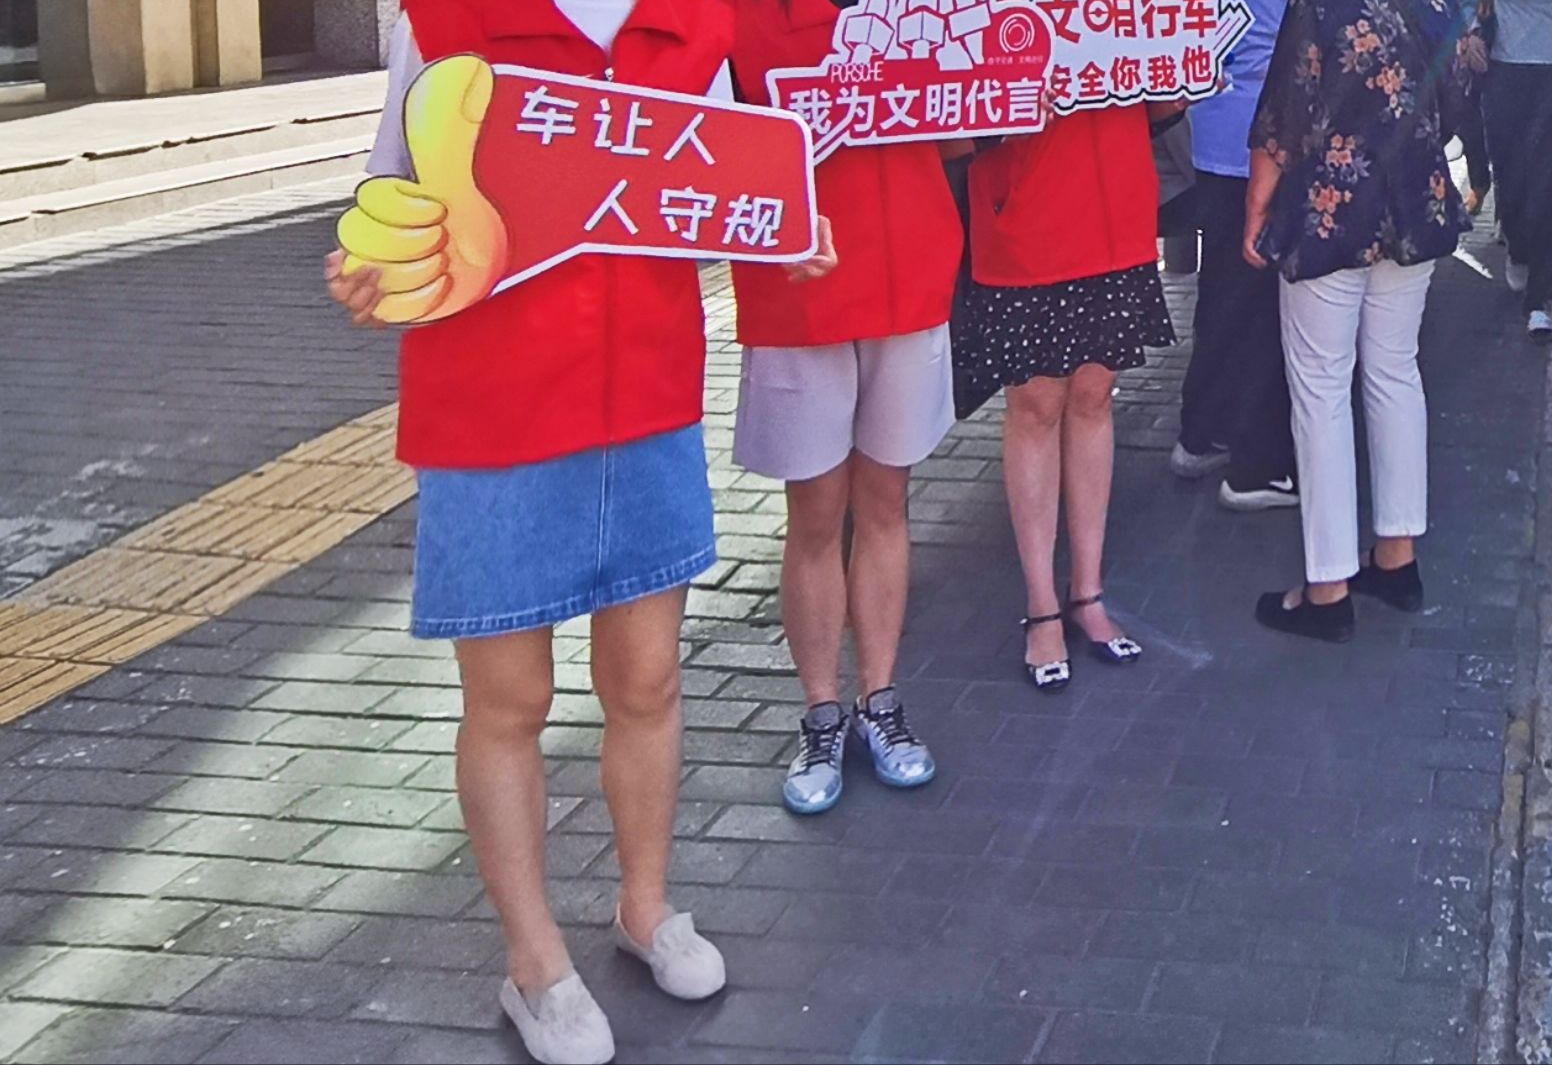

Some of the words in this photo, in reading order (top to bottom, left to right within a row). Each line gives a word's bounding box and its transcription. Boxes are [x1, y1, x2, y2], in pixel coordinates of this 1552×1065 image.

[1051, 44, 1213, 100] 安全你我他
[516, 85, 716, 165] 车让人
[788, 77, 1043, 134] 我为文明代言
[584, 179, 784, 247] 人守规
